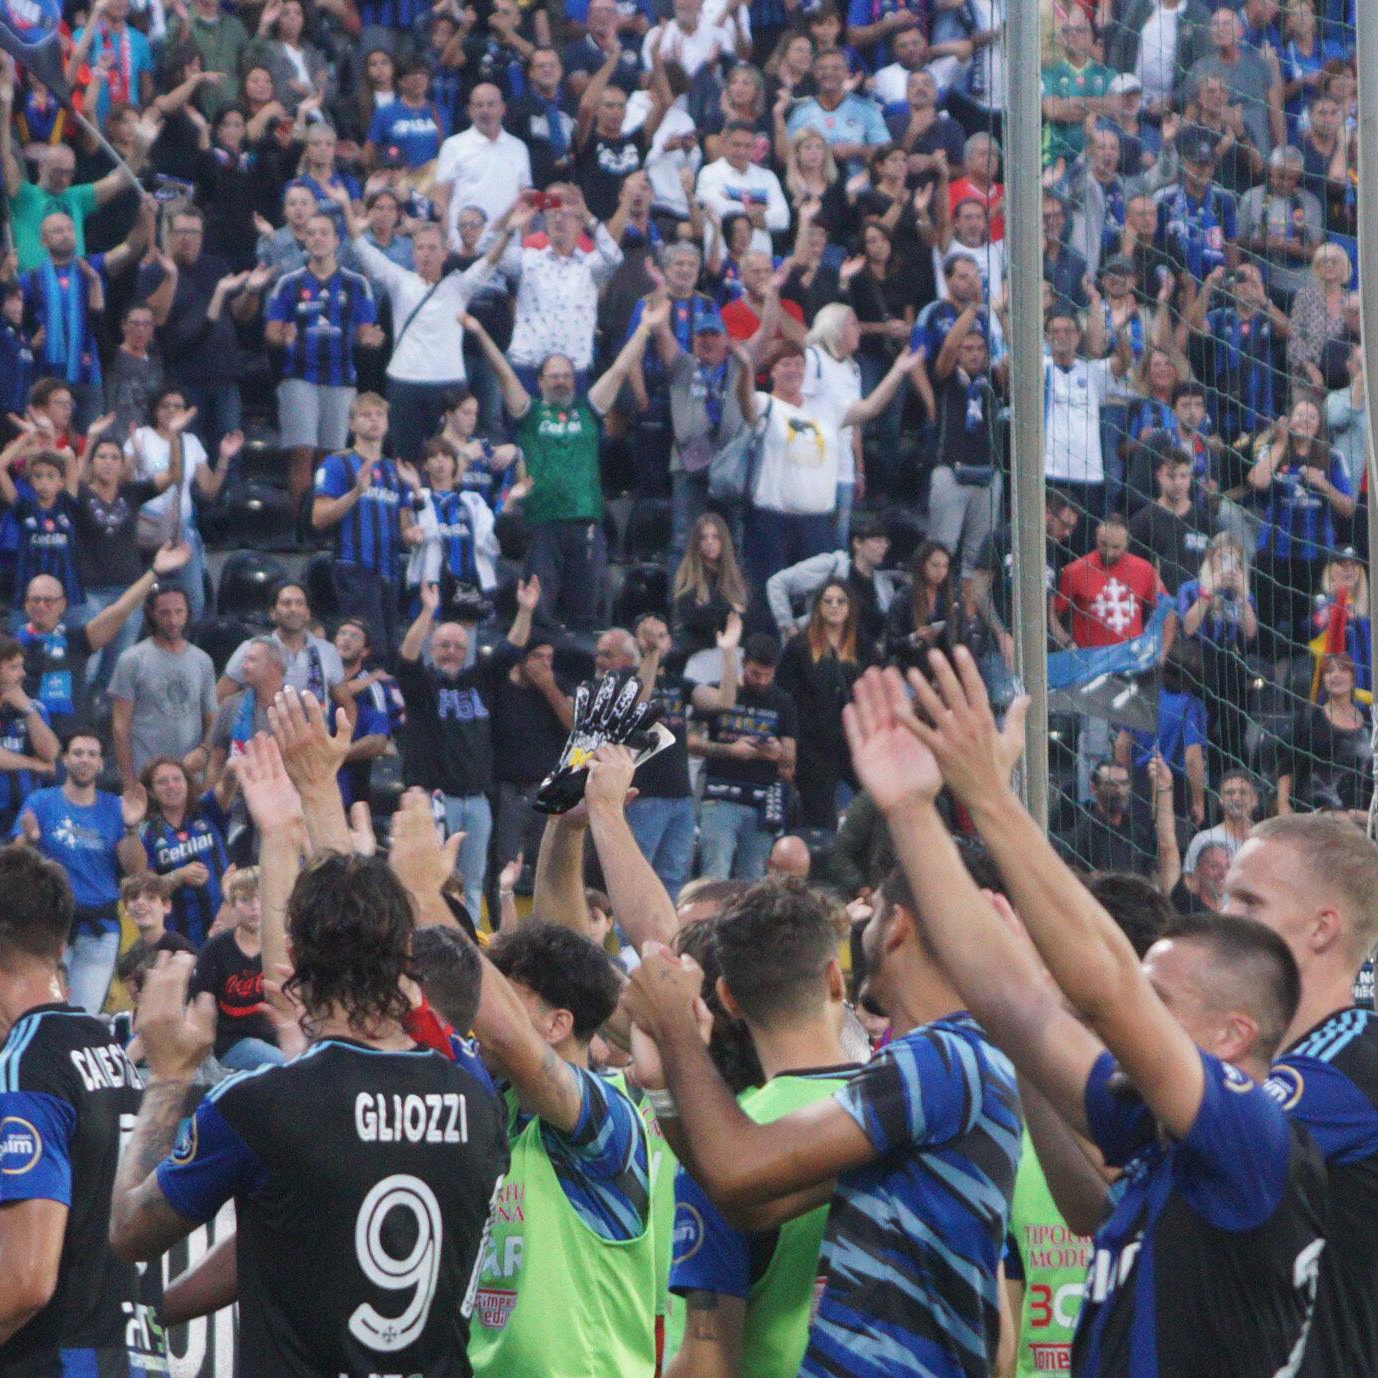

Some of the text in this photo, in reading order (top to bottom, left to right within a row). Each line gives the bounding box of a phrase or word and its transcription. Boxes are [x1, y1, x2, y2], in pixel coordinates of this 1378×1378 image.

[160, 833, 215, 867] Cetilar
[354, 1091, 469, 1143] GLIOZZI
[348, 1172, 445, 1352] 9
